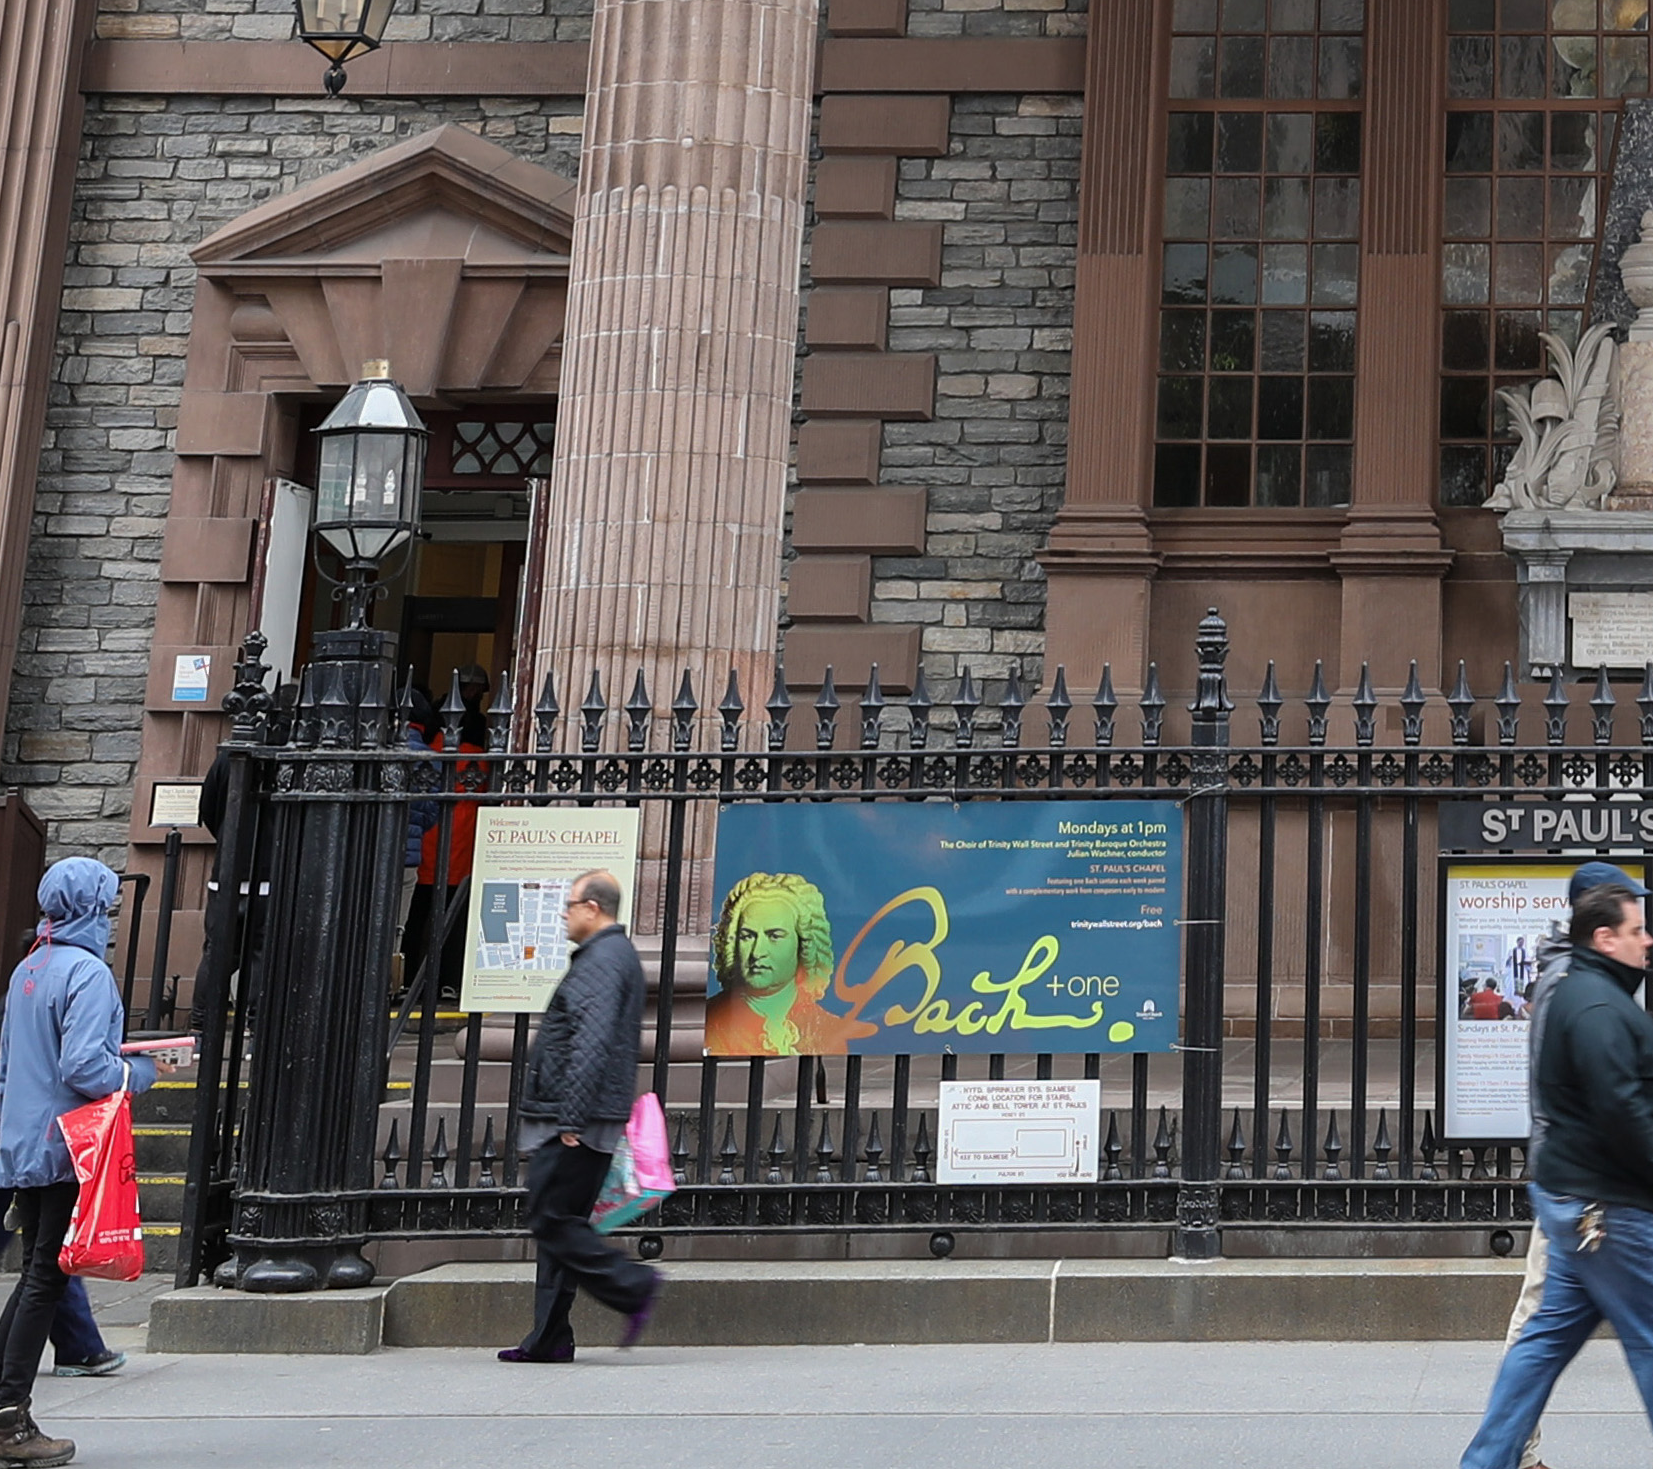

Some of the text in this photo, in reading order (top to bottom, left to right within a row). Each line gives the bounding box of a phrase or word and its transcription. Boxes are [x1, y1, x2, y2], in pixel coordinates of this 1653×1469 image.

[489, 818, 520, 826] Welcome
[1058, 821, 1166, 837] Mondays at 1pm
[487, 830, 621, 844] ST. PAUL'S CHAPEL
[941, 840, 1166, 850] The Choir of Trinity Wall Street and Trinity Baroque Orchestra
[1067, 850, 1090, 858] Julian
[1091, 850, 1126, 858] Wachner,
[1090, 865, 1166, 873] ST. PAUL'S CHAPEL
[1460, 881, 1528, 889] ST. PAUL'S CHAPEL
[1459, 892, 1573, 914] worship serv
[1141, 905, 1162, 915] Free
[1071, 920, 1162, 929] trinitywallstreet.org/bach
[1046, 975, 1120, 997] +one
[1458, 1024, 1488, 1034] Sundays
[1500, 1024, 1510, 1032] St.
